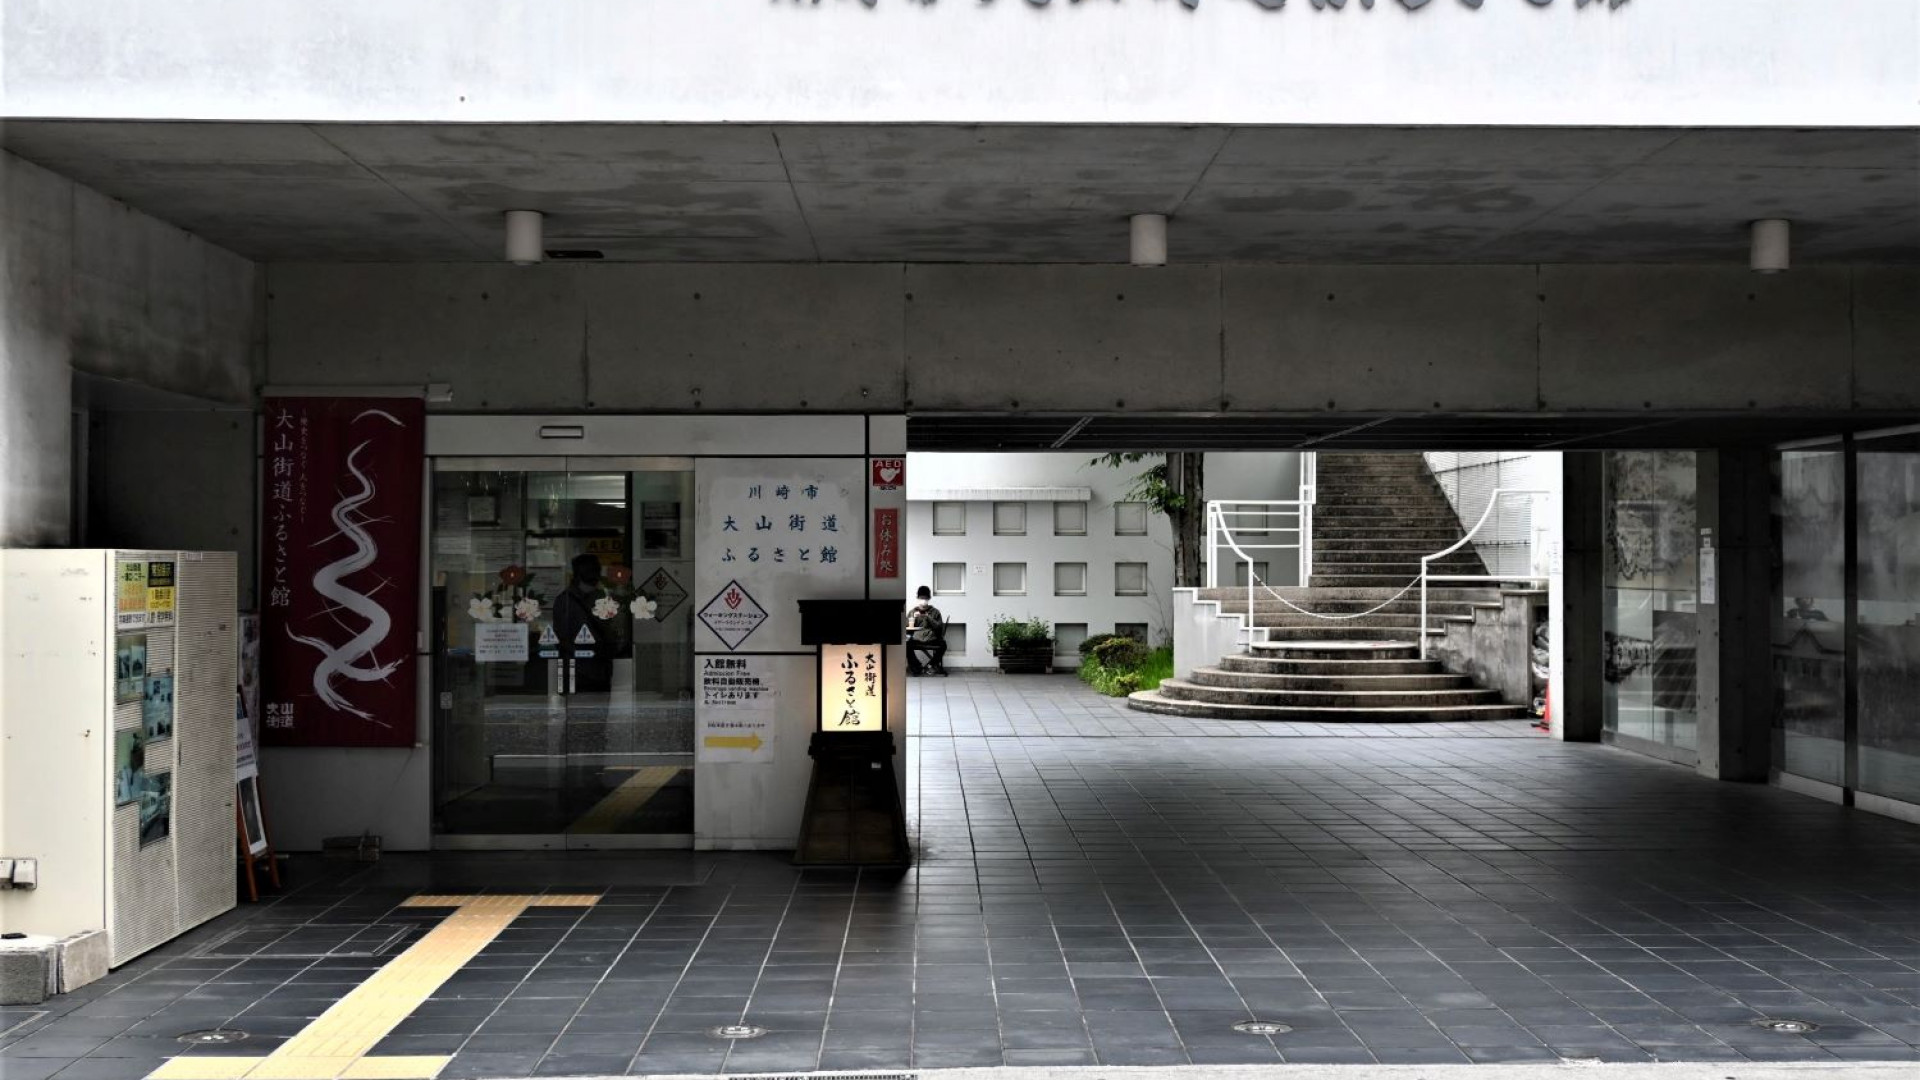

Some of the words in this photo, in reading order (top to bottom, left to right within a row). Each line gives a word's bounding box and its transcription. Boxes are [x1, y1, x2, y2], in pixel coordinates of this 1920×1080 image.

[875, 460, 902, 469] AED
[271, 408, 295, 607] 大山街道ふるさと館
[722, 514, 840, 532] 大山街道
[721, 546, 838, 564] ふるさと館
[704, 659, 746, 669] 入館無料
[704, 677, 760, 686] 飲料自動販売機
[864, 651, 877, 697] 大山街道
[705, 692, 759, 700] トイレあります
[838, 652, 861, 726] ふるさと館
